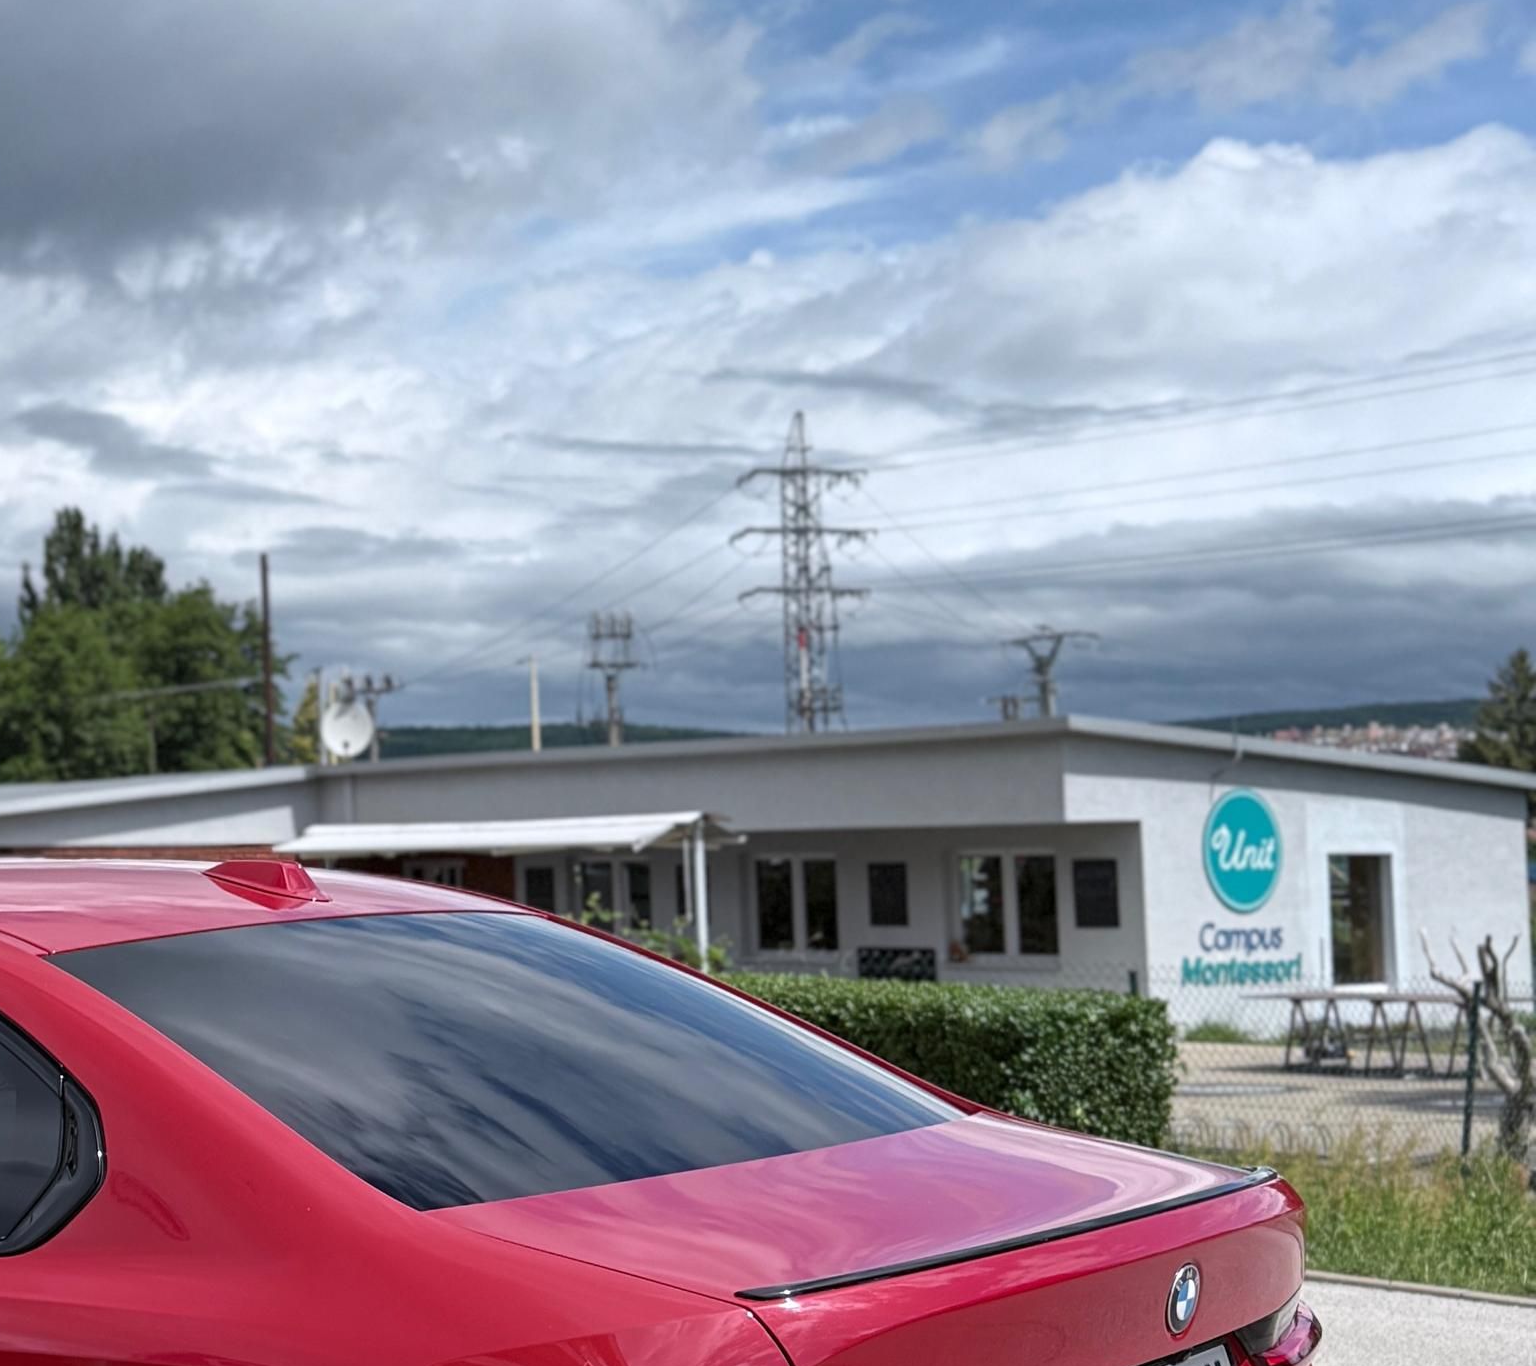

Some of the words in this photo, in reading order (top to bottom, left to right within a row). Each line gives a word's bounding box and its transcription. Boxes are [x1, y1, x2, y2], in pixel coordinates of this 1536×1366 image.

[1211, 823, 1275, 870] Unit
[1199, 922, 1283, 956] Campus
[1181, 953, 1302, 986] Montessori
